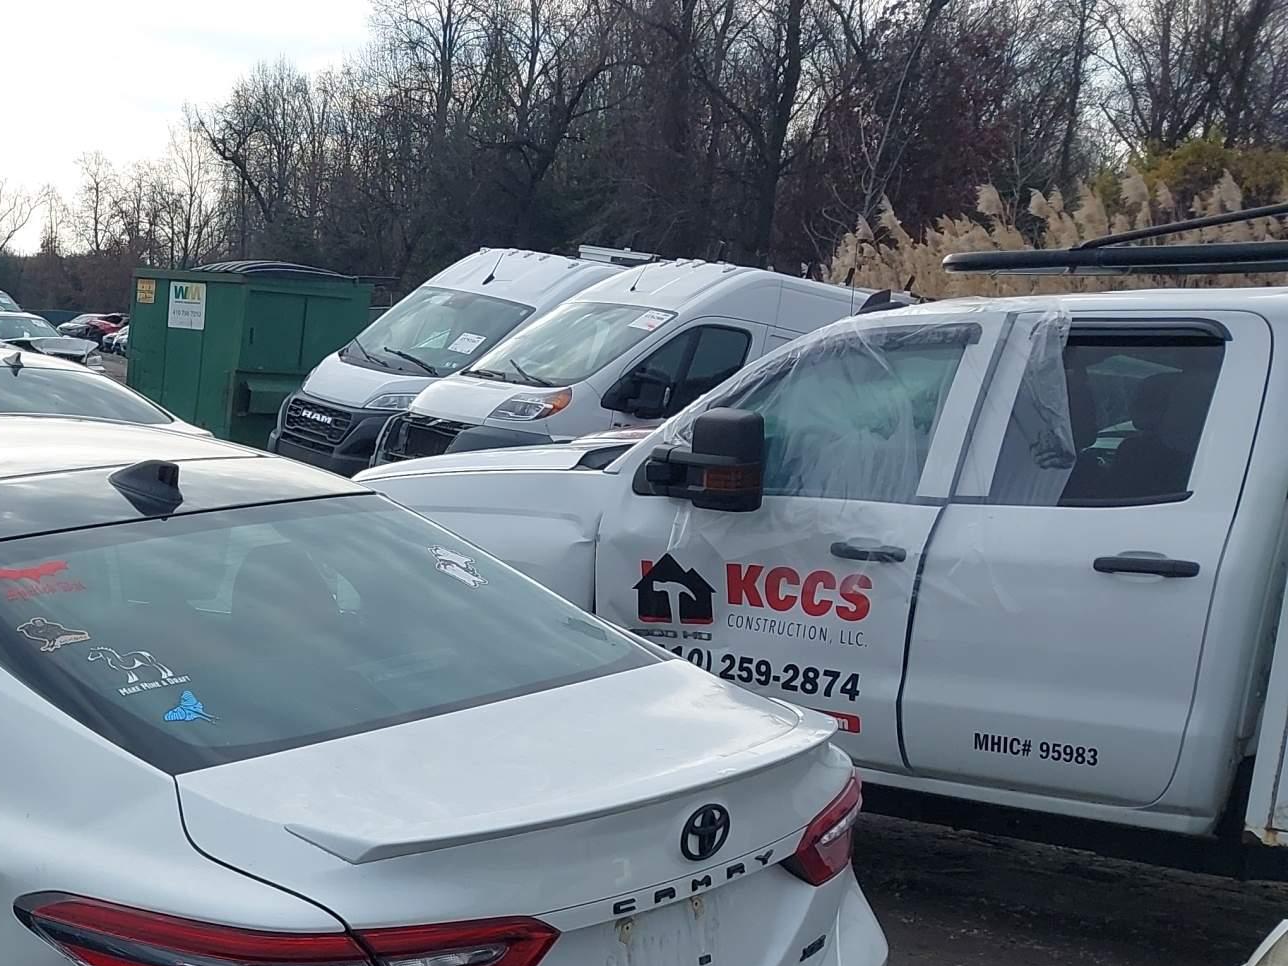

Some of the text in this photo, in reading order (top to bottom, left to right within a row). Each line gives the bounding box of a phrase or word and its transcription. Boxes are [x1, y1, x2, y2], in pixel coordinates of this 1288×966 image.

[174, 285, 201, 300] WM
[302, 409, 333, 424] RAM
[725, 563, 873, 622] KCCS
[727, 613, 868, 648] CONSTRUCTION, LLC.
[719, 653, 861, 702] 259-2874
[974, 732, 1099, 767] MHIC# 95983
[612, 849, 774, 915] CAMRY
